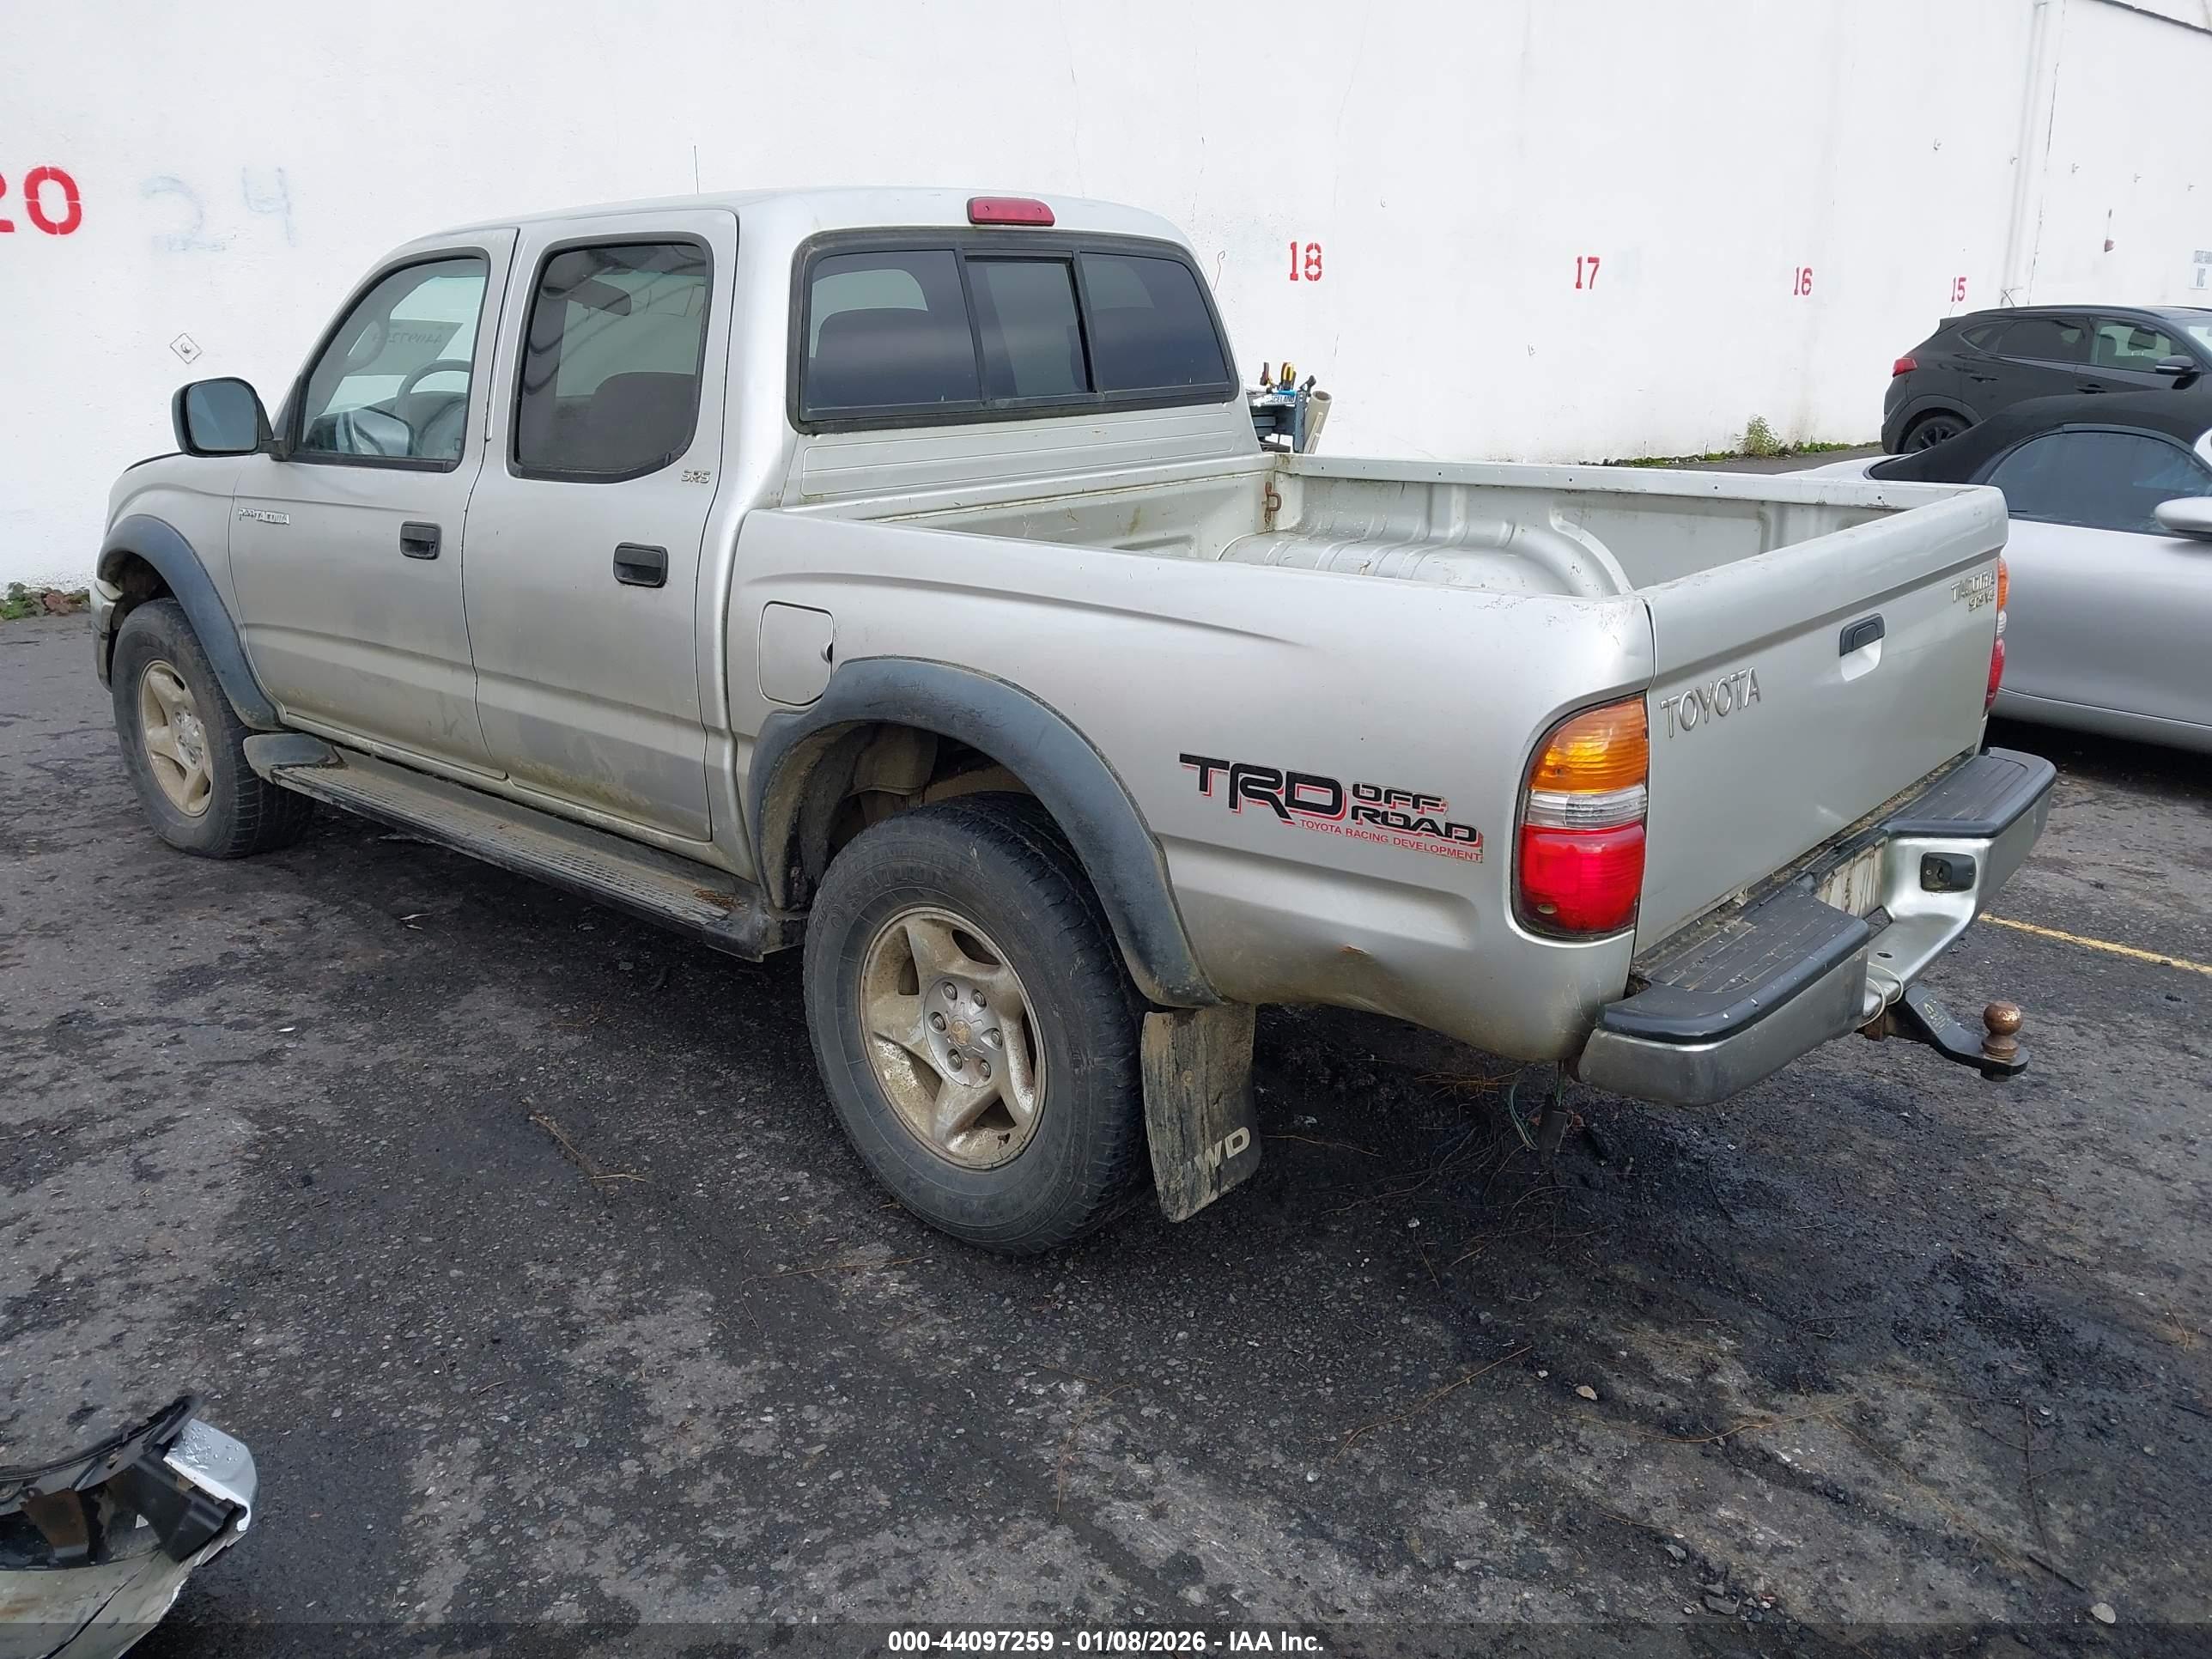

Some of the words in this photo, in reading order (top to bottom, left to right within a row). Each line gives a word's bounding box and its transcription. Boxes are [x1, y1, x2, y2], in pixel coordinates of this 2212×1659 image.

[1290, 241, 1322, 282] 18
[1576, 256, 1600, 289] 17
[1794, 266, 1813, 296] 16
[1951, 276, 1966, 302] 15
[1660, 666, 1761, 738] TOYOTA
[1179, 753, 1347, 827] TRD
[1352, 781, 1449, 816] OFF
[1300, 818, 1342, 835] TOYOTA
[1346, 827, 1389, 843] RACING
[1393, 837, 1483, 862] DEVELOPMENT
[1351, 805, 1483, 848] ROAD
